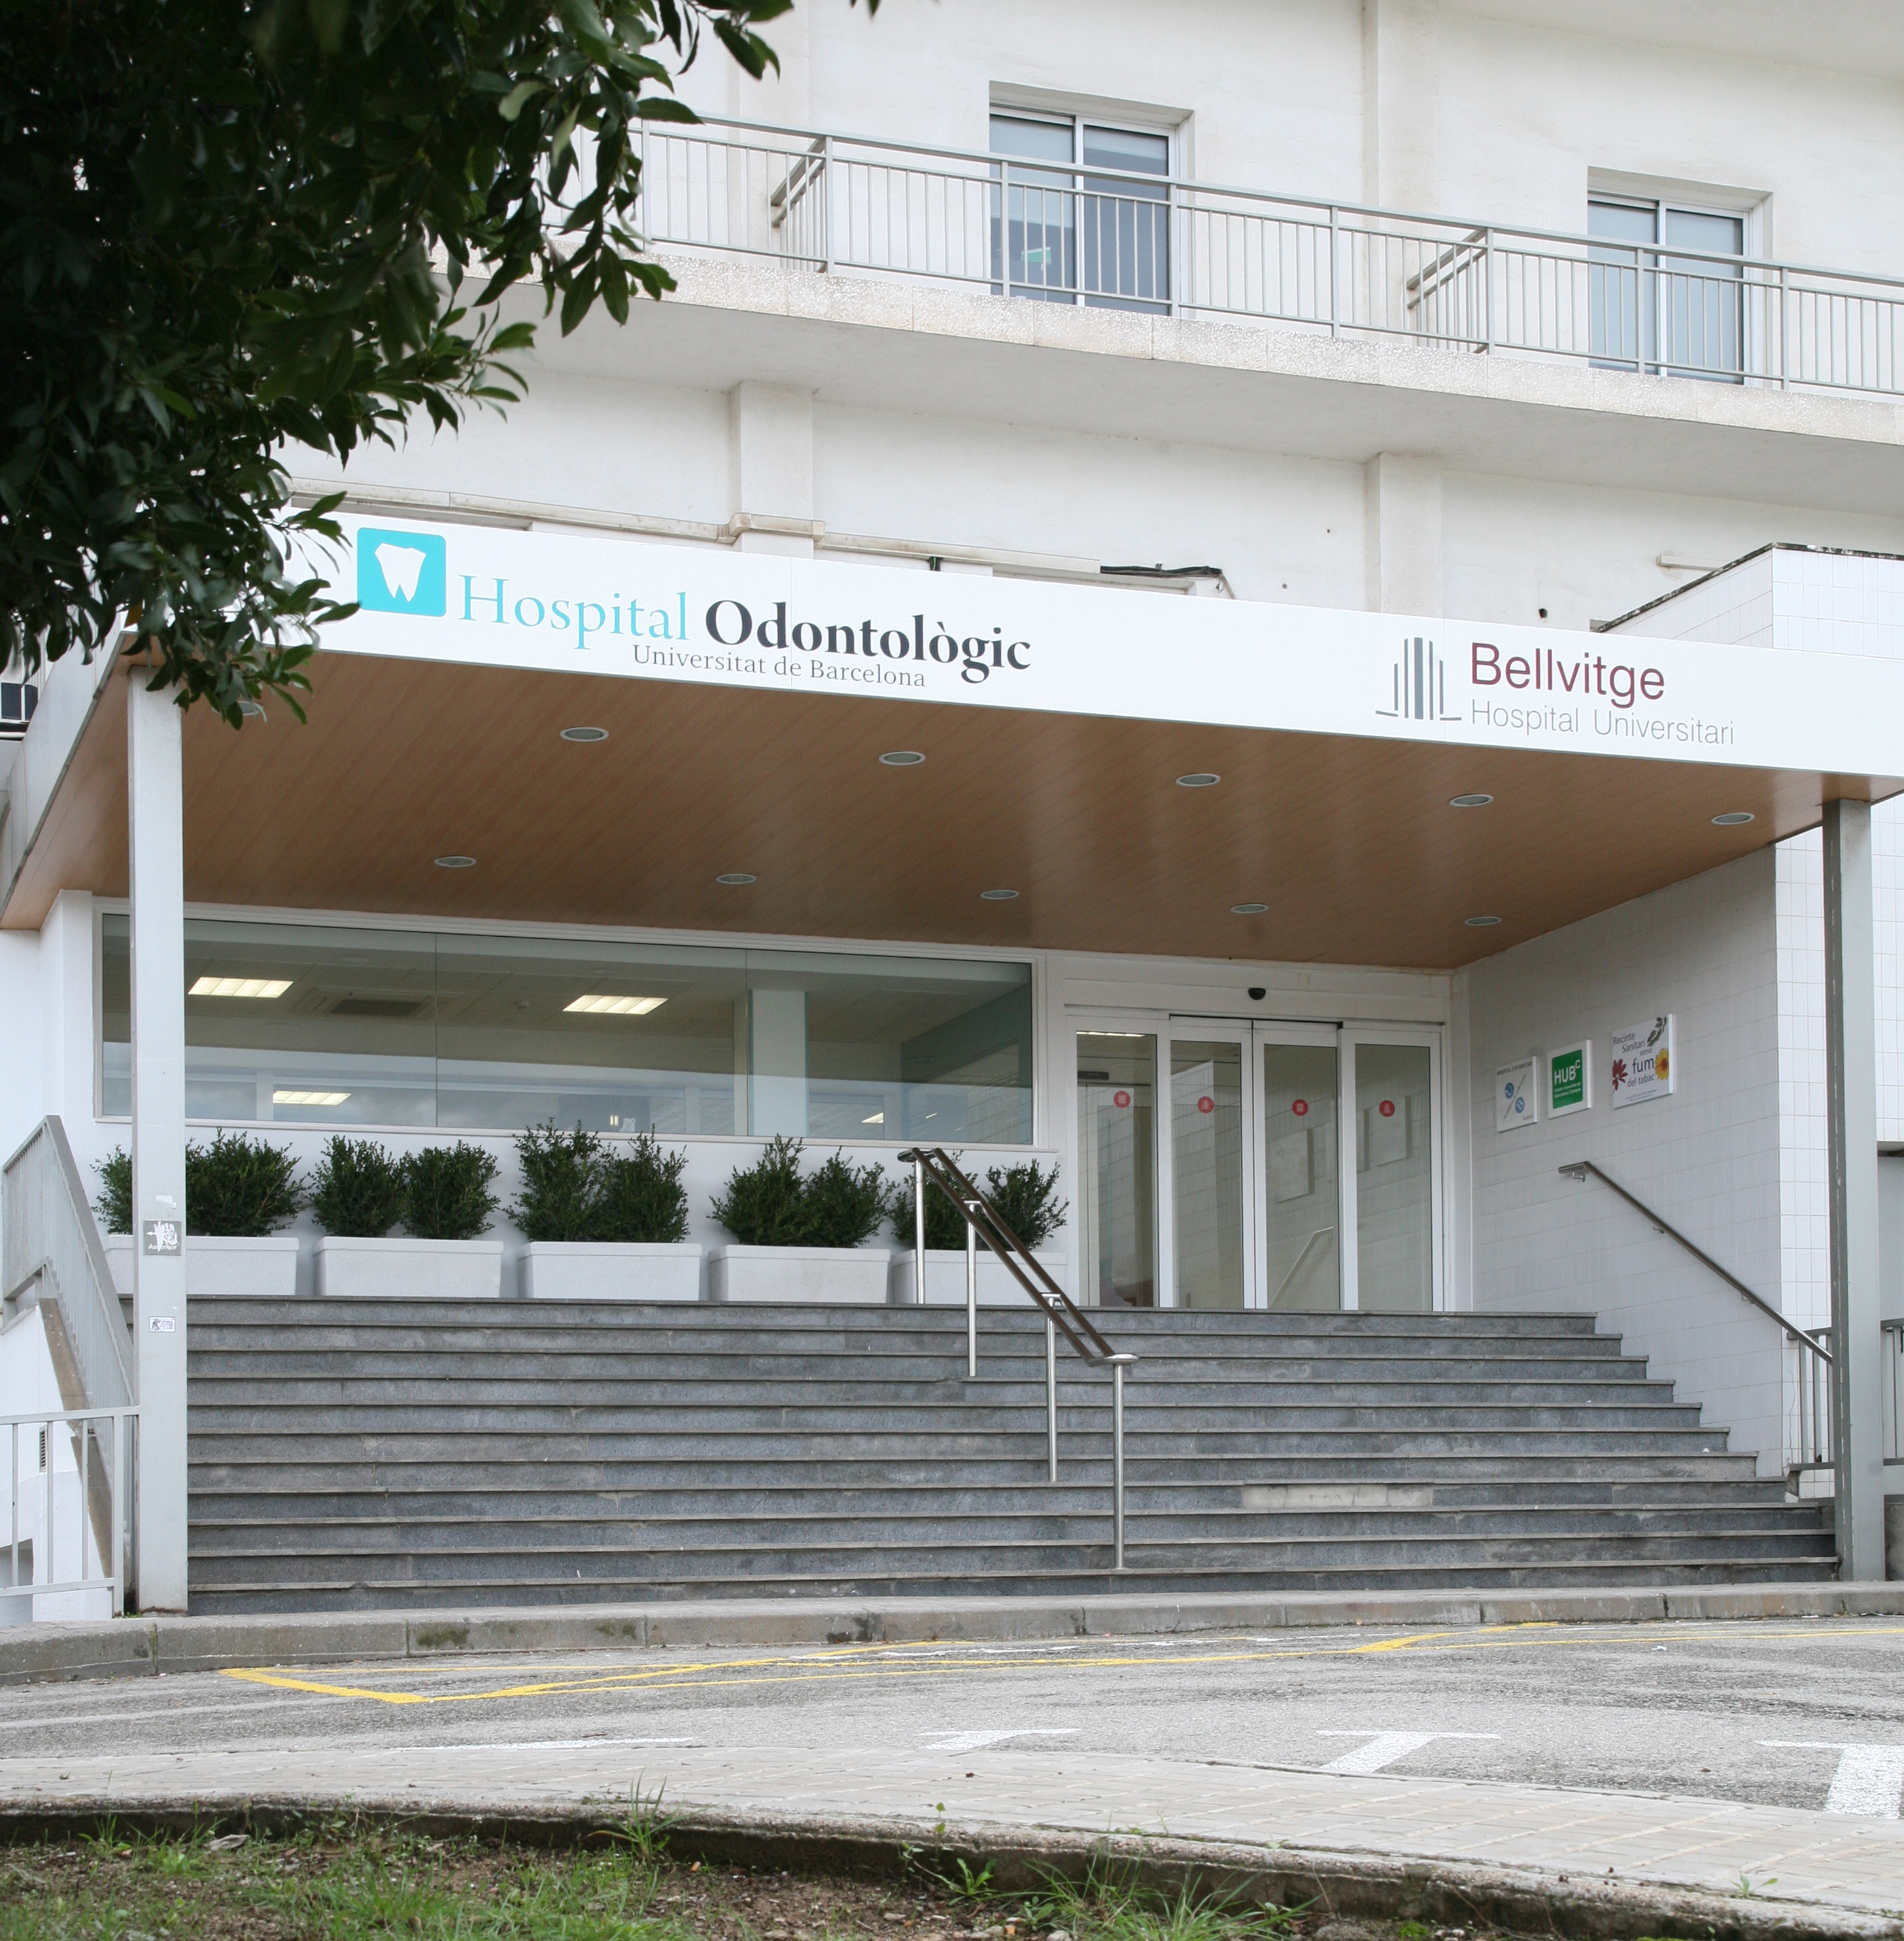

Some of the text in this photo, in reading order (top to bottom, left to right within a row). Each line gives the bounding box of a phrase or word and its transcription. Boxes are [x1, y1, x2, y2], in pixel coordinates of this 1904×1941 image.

[459, 575, 1031, 684] Hospital Odontològic
[632, 644, 926, 687] Universitat de Barcelona
[1472, 642, 1665, 709] Bellvitge
[1472, 699, 1734, 745] Hospital Universitari
[1612, 1032, 1635, 1045] Recinte
[1622, 1038, 1646, 1053] Sanitari
[1627, 1073, 1656, 1088] del tabac
[1632, 1057, 1654, 1074] fum
